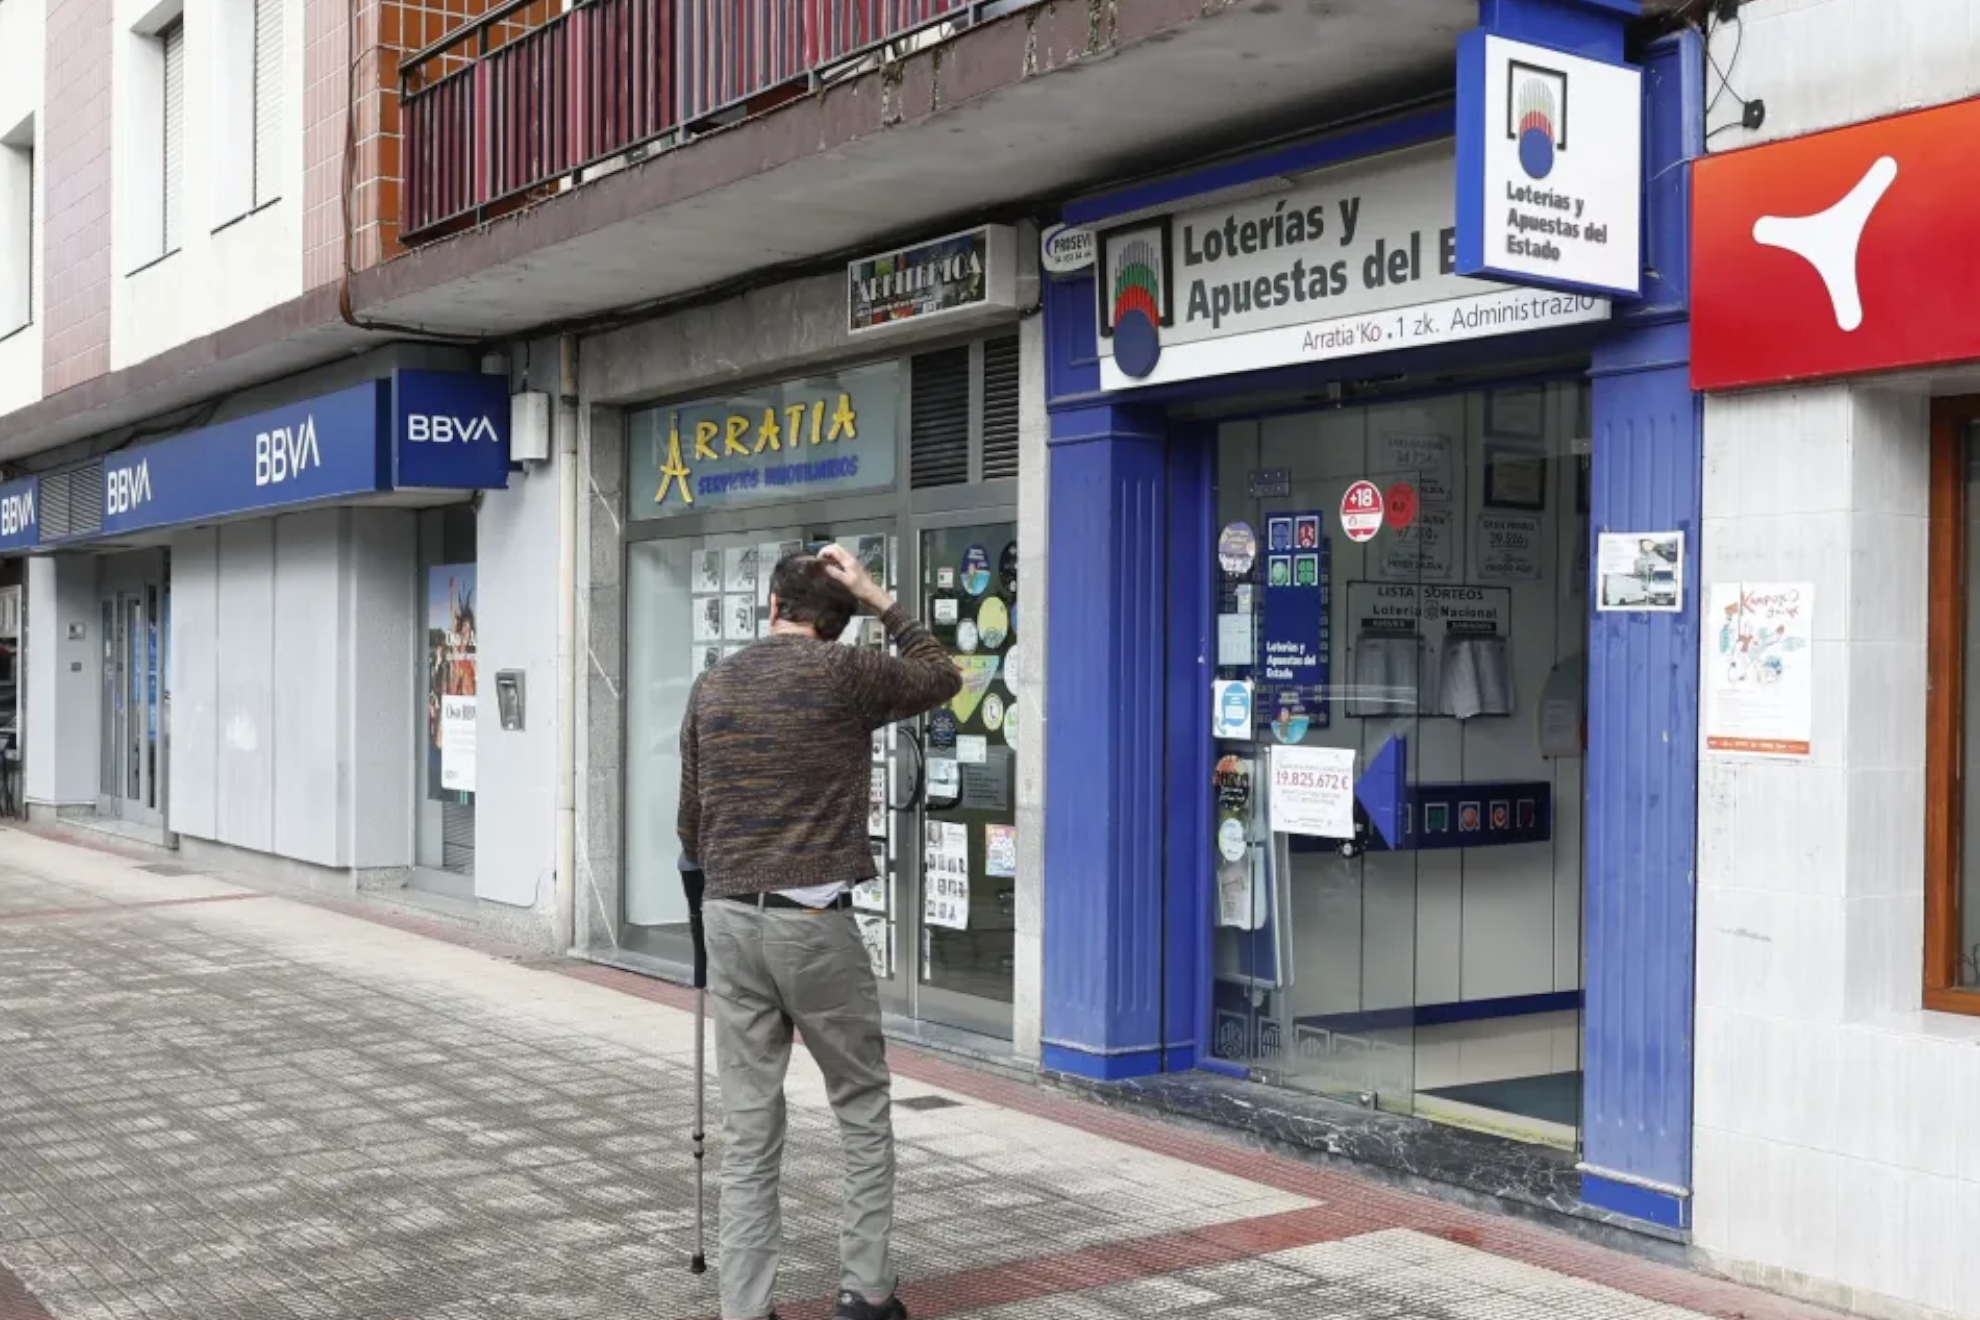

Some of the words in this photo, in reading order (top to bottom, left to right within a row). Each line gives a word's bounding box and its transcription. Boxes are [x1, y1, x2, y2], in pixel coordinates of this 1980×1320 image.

[1507, 181, 1570, 210] Loterías
[1575, 199, 1584, 218] y
[1184, 199, 1324, 265] Loterías
[1339, 197, 1361, 246] y
[1507, 208, 1579, 238] Apuestas
[1584, 222, 1607, 243] del
[1507, 234, 1560, 261] Estado
[1186, 257, 1346, 329] Apuestas
[1363, 232, 1420, 289] del
[1451, 294, 1595, 330] Administrazio
[408, 414, 498, 443] BBVA
[256, 415, 320, 486] BBVA
[654, 393, 857, 503] ARRATIA
[107, 458, 151, 515] BBVA
[1350, 488, 1373, 507] +18
[1, 488, 35, 535] BBVA
[1377, 587, 1415, 598] LISTA
[1424, 588, 1484, 601] SORTEOS
[1441, 605, 1498, 619] Nacional
